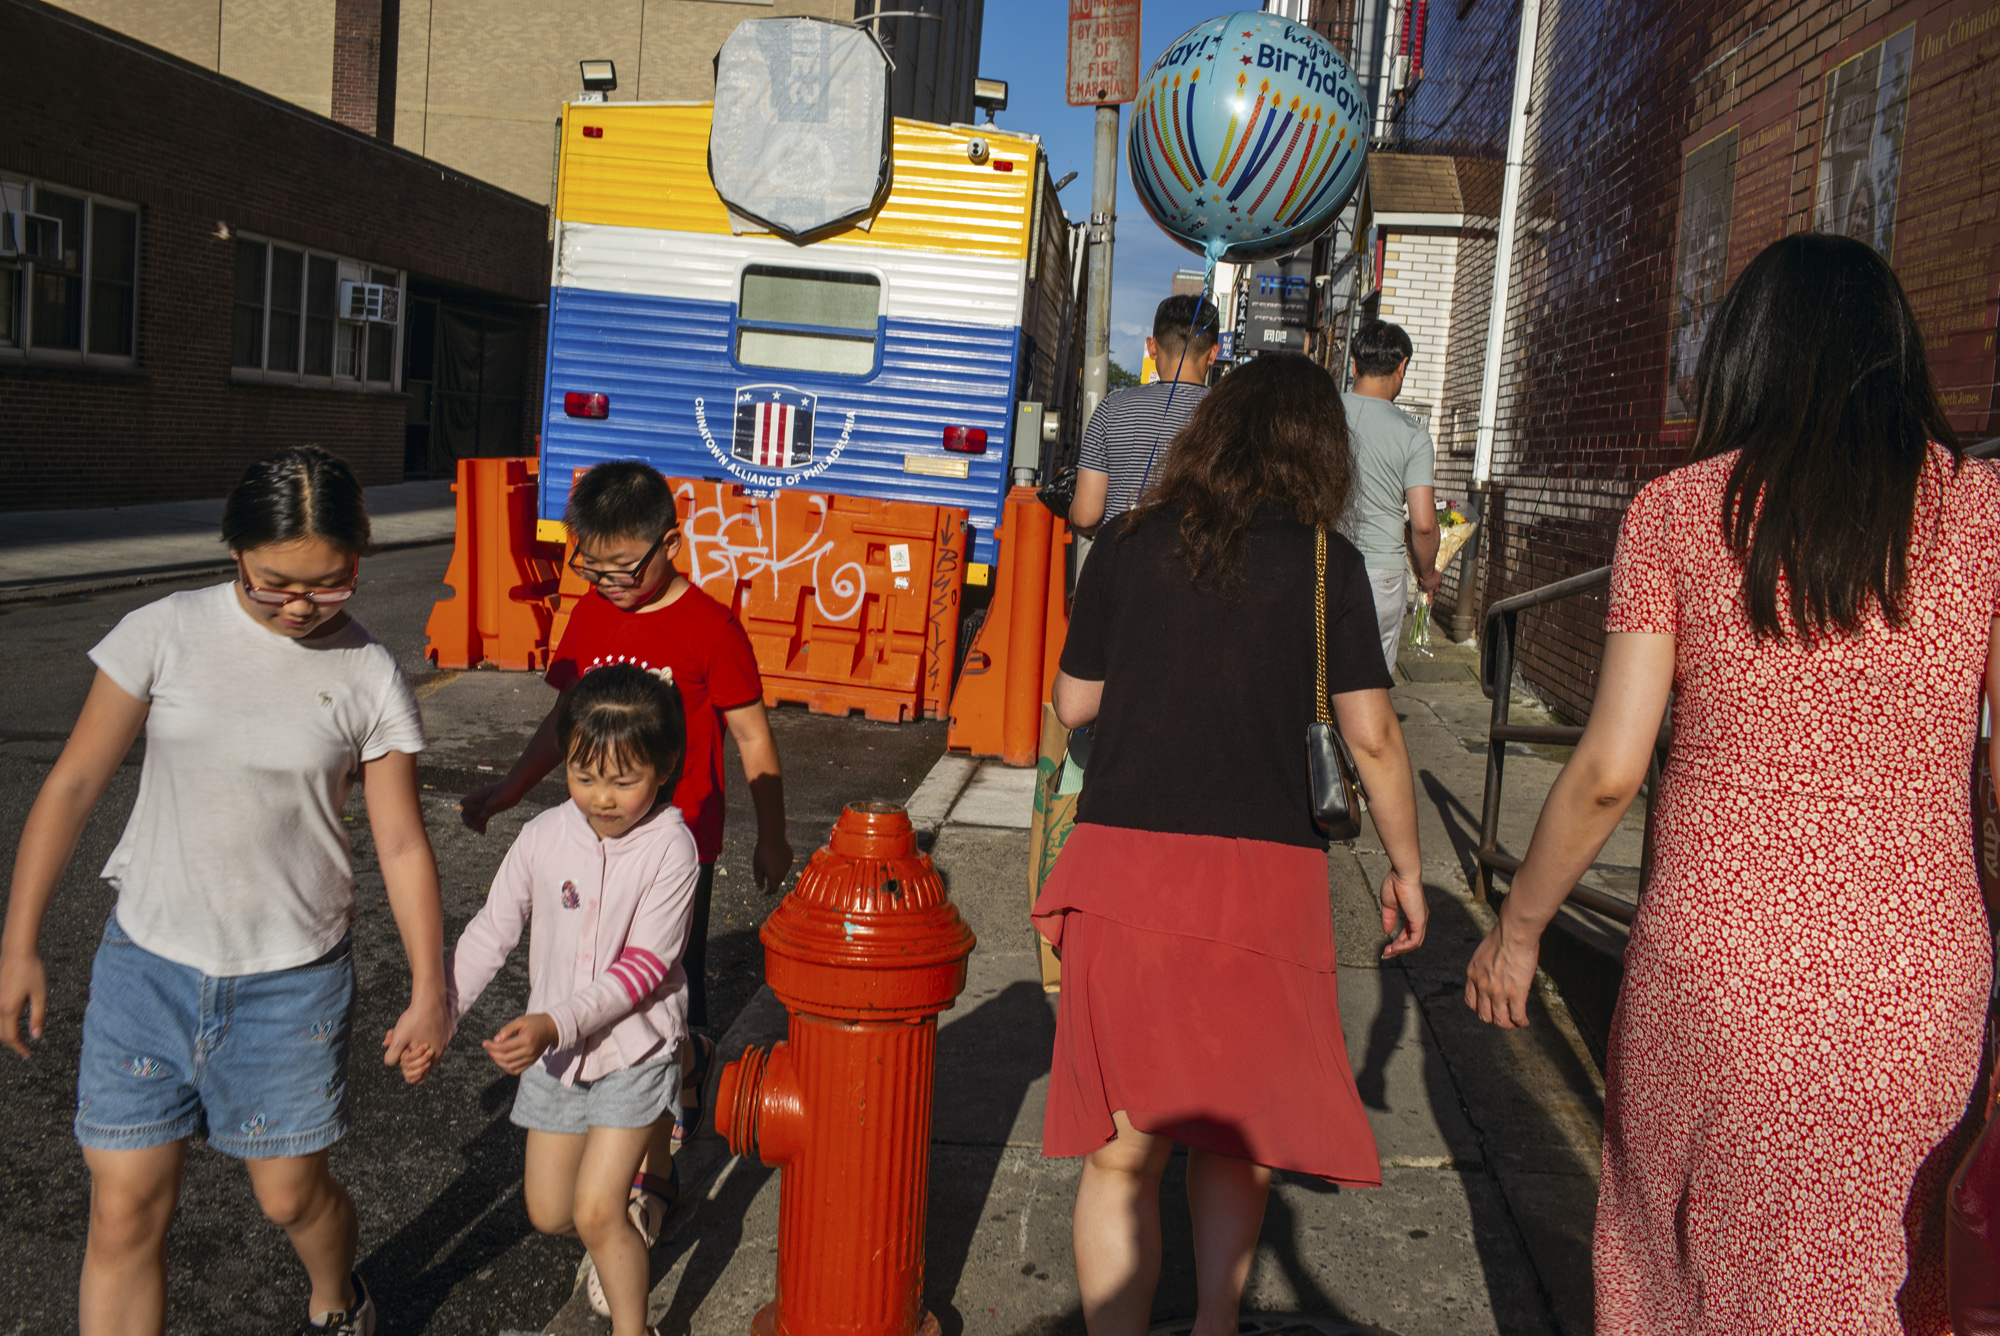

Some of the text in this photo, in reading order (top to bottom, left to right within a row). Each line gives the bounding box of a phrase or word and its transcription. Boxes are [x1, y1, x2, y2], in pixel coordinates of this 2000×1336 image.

[1078, 21, 1132, 40] BY ORDER
[1096, 41, 1111, 58] OF
[1284, 25, 1347, 80] happy
[1921, 33, 1946, 61] Our
[1088, 59, 1118, 79] FIRE
[1076, 79, 1127, 97] MARSHAL
[1258, 43, 1363, 126] Birthday!
[1743, 119, 1791, 156] Our Chinatown
[1263, 329, 1287, 344] 网吧
[1957, 391, 1979, 405] Jones
[695, 397, 856, 487] CHINATOWN ALLIANCE OF PHILADELPHIA
